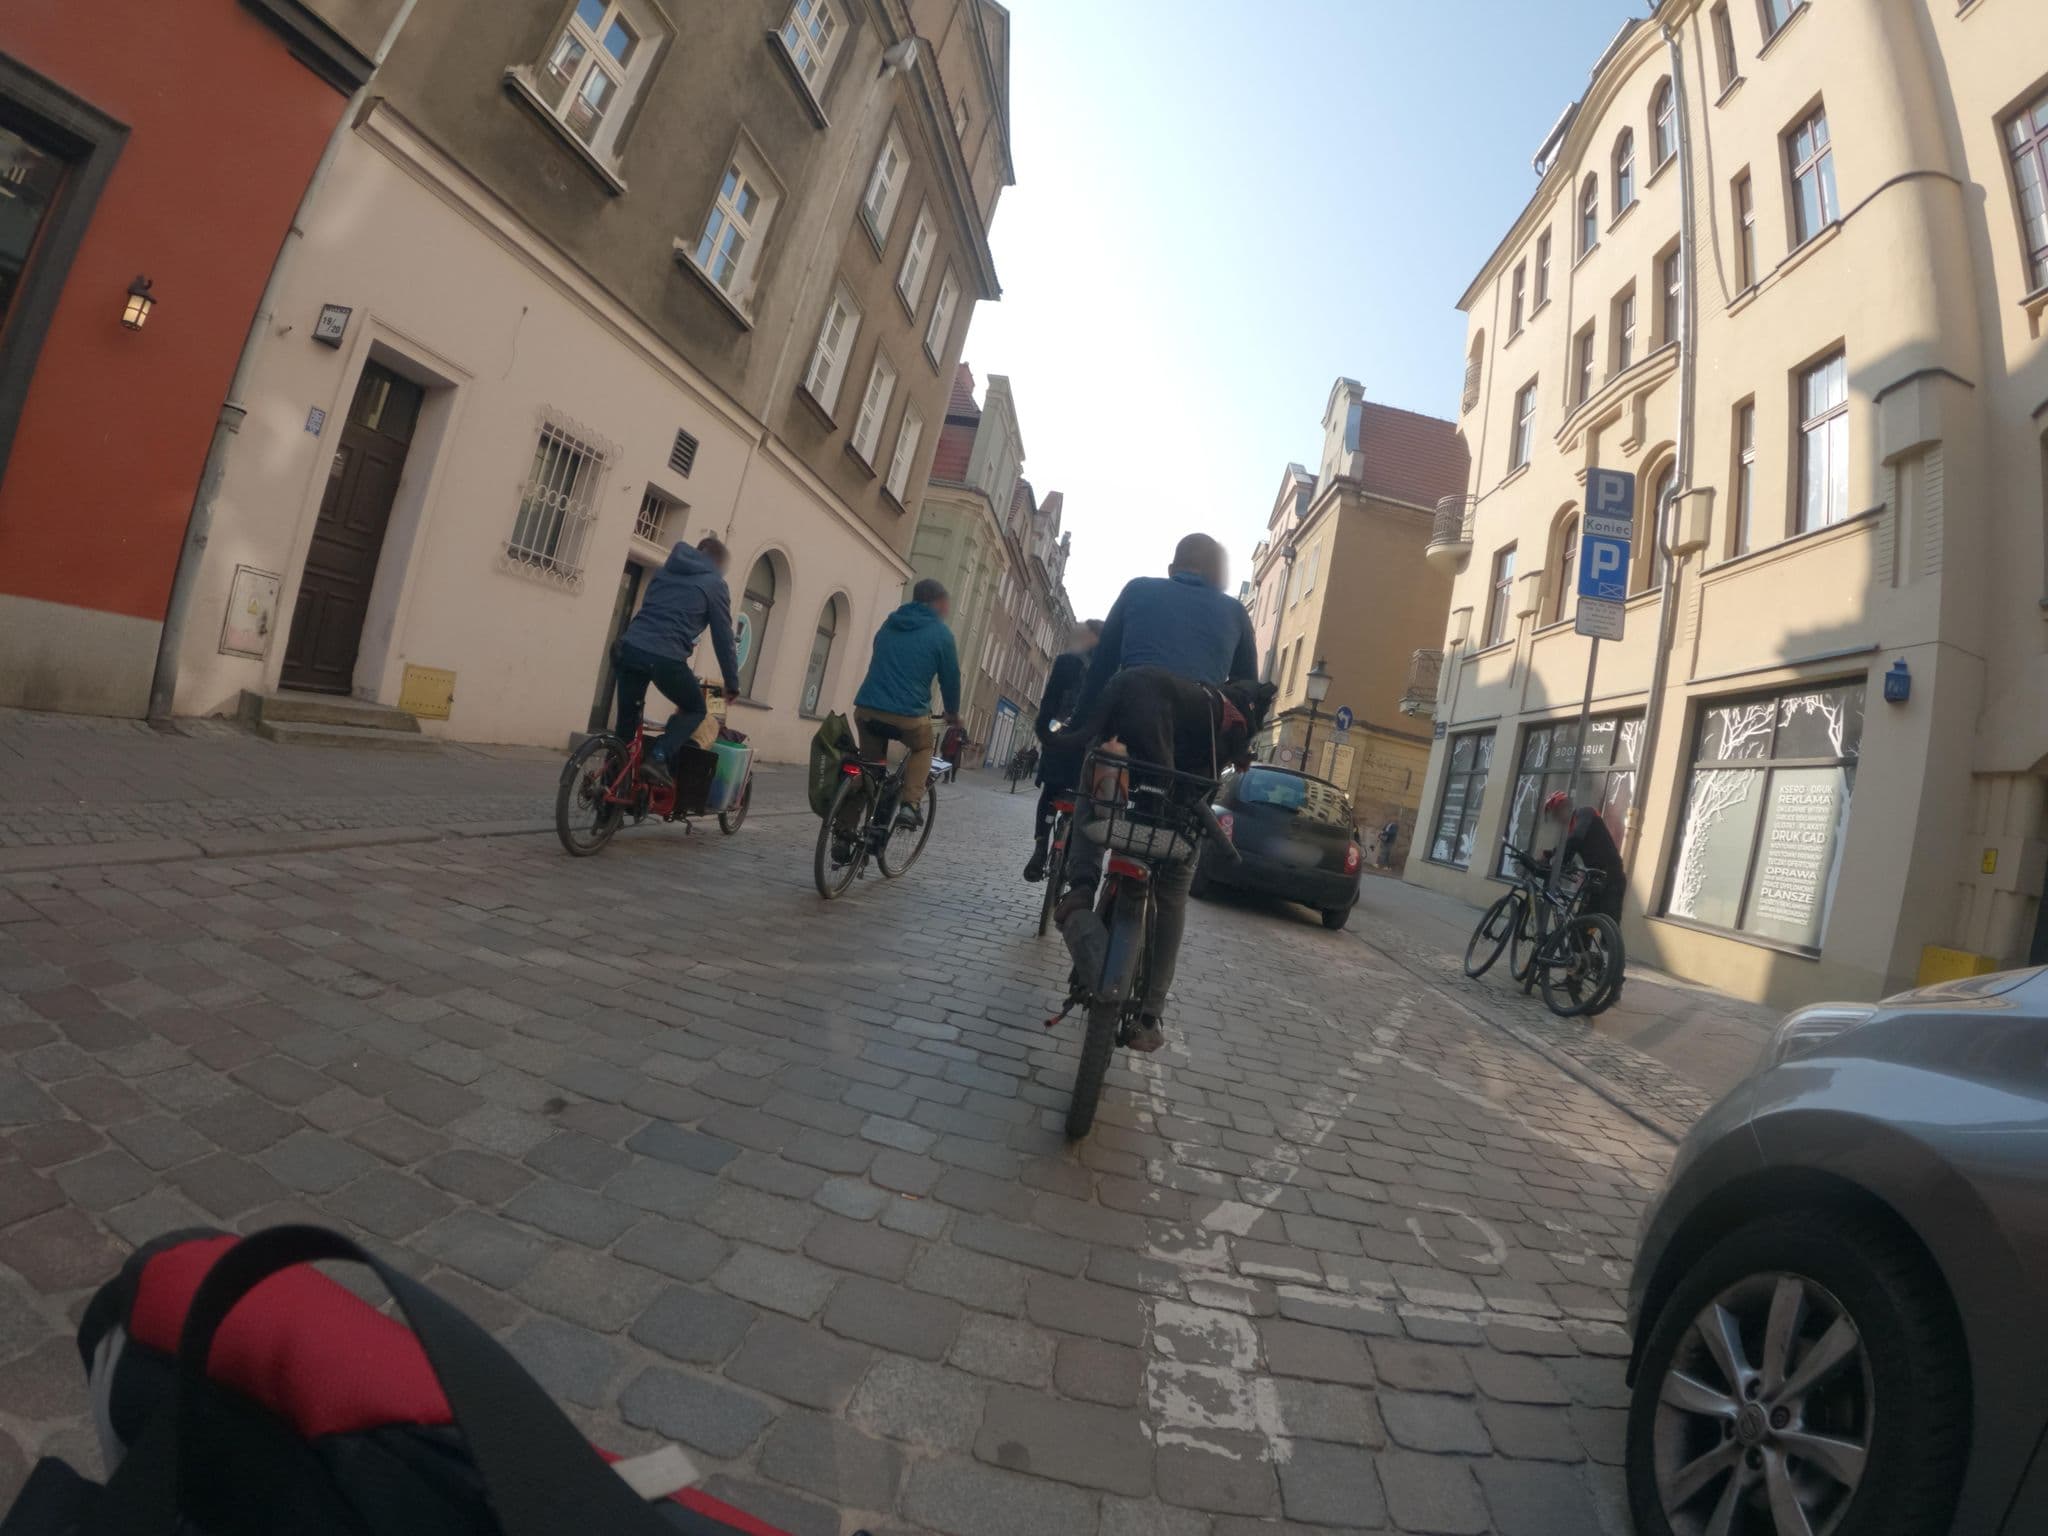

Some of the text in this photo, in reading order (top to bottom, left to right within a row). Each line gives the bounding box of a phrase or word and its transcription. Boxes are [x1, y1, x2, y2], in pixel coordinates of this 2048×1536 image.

[1597, 474, 1625, 510] P
[1586, 519, 1630, 536] Koniec
[1591, 541, 1620, 580] P
[1778, 794, 1832, 805] REKLAMA
[1772, 830, 1825, 844] DRUK CAD
[1765, 866, 1817, 881] OPRAWA
[1760, 887, 1816, 904] PLANSZE
